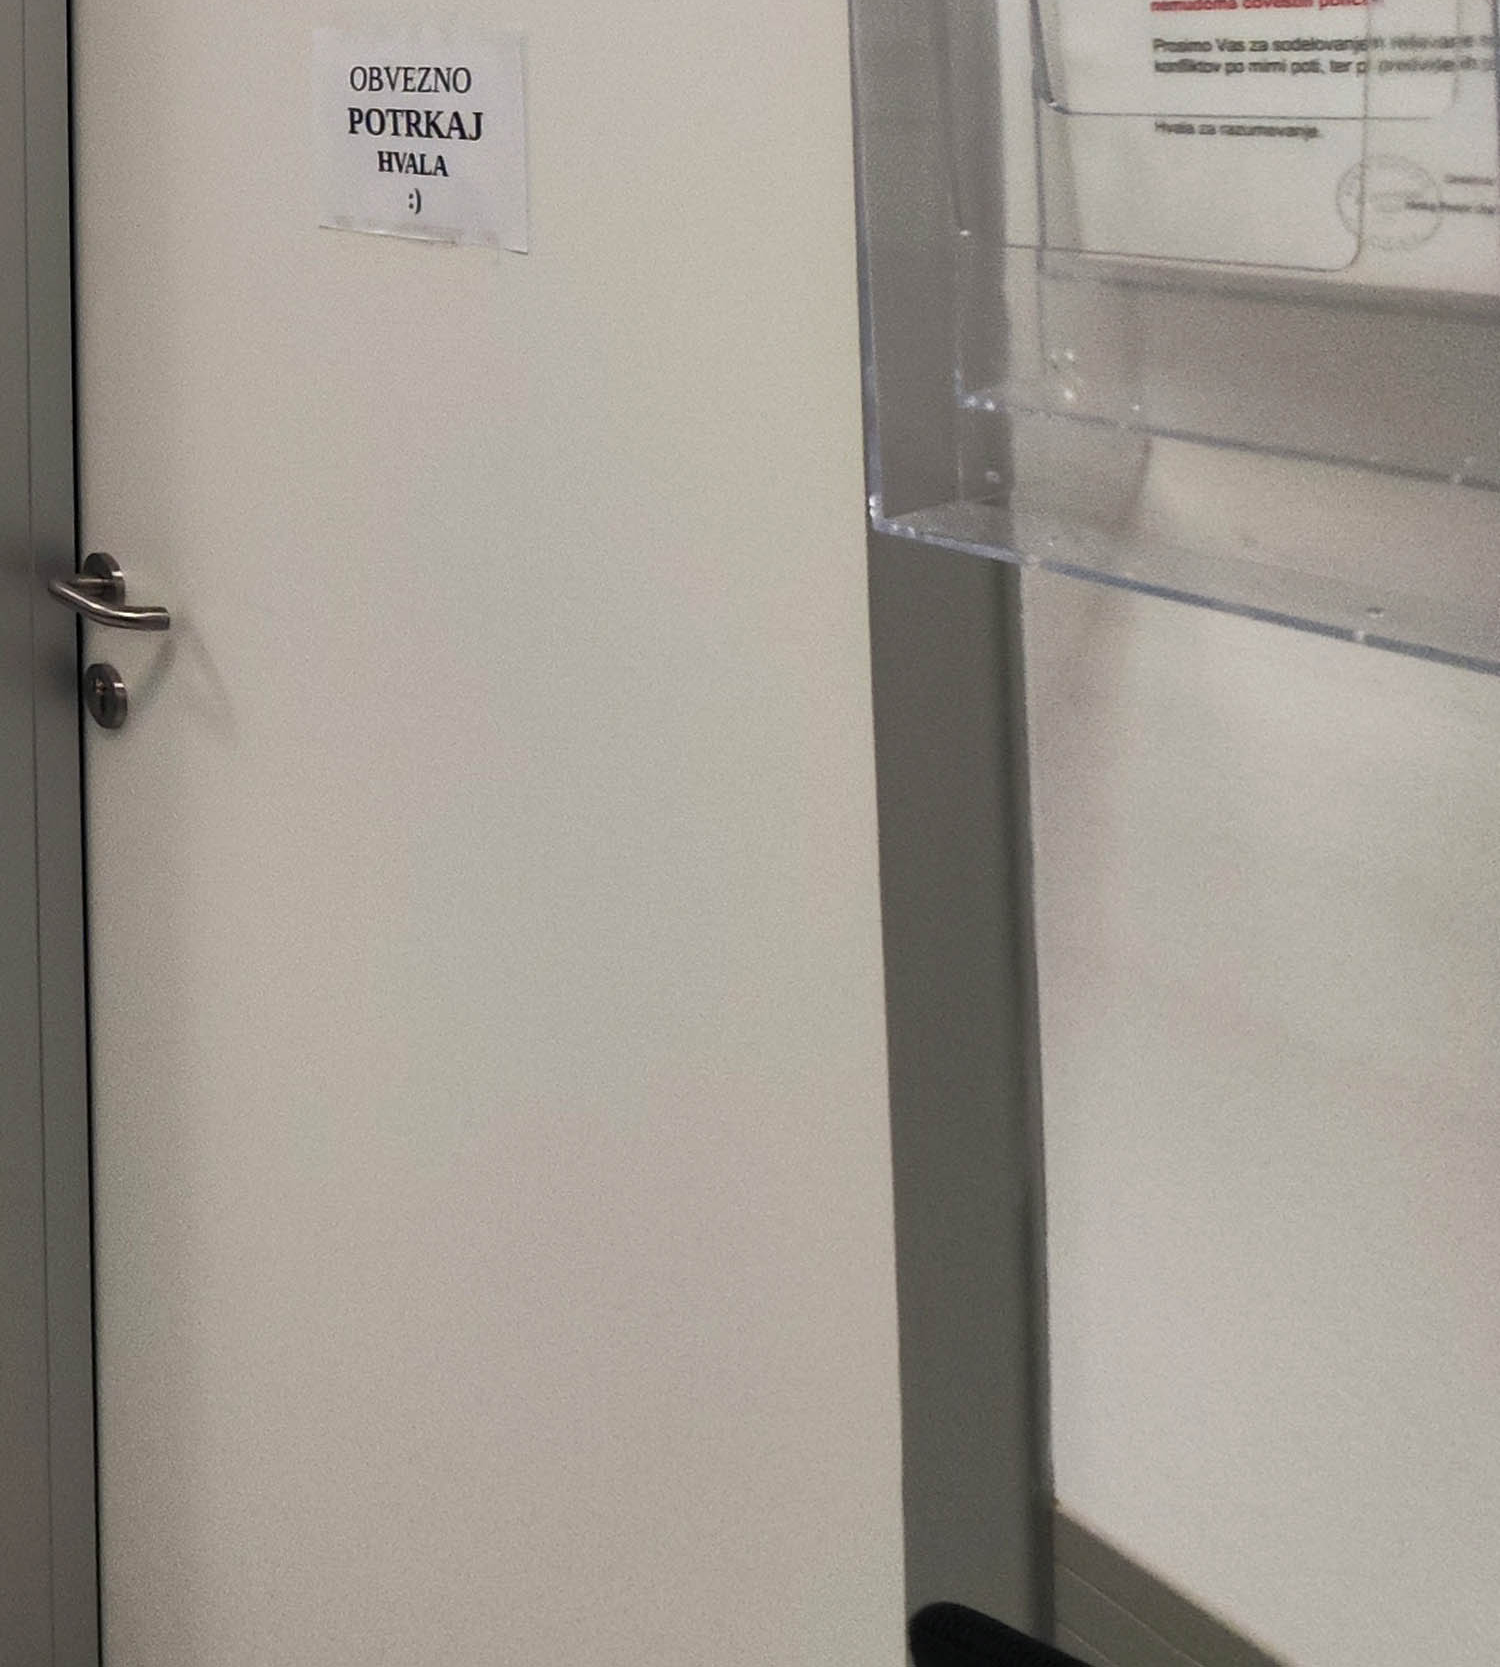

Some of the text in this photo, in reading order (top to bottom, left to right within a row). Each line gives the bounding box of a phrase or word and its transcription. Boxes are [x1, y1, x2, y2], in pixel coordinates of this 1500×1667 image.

[1153, 38, 1213, 53] Prosimo
[1214, 38, 1245, 52] Vas
[1248, 40, 1269, 52] za
[350, 66, 473, 94] OBVEZNO
[1224, 61, 1245, 76] po
[1329, 60, 1353, 73] ter
[348, 107, 484, 142] POTRKAJ
[377, 150, 450, 178] HVALA
